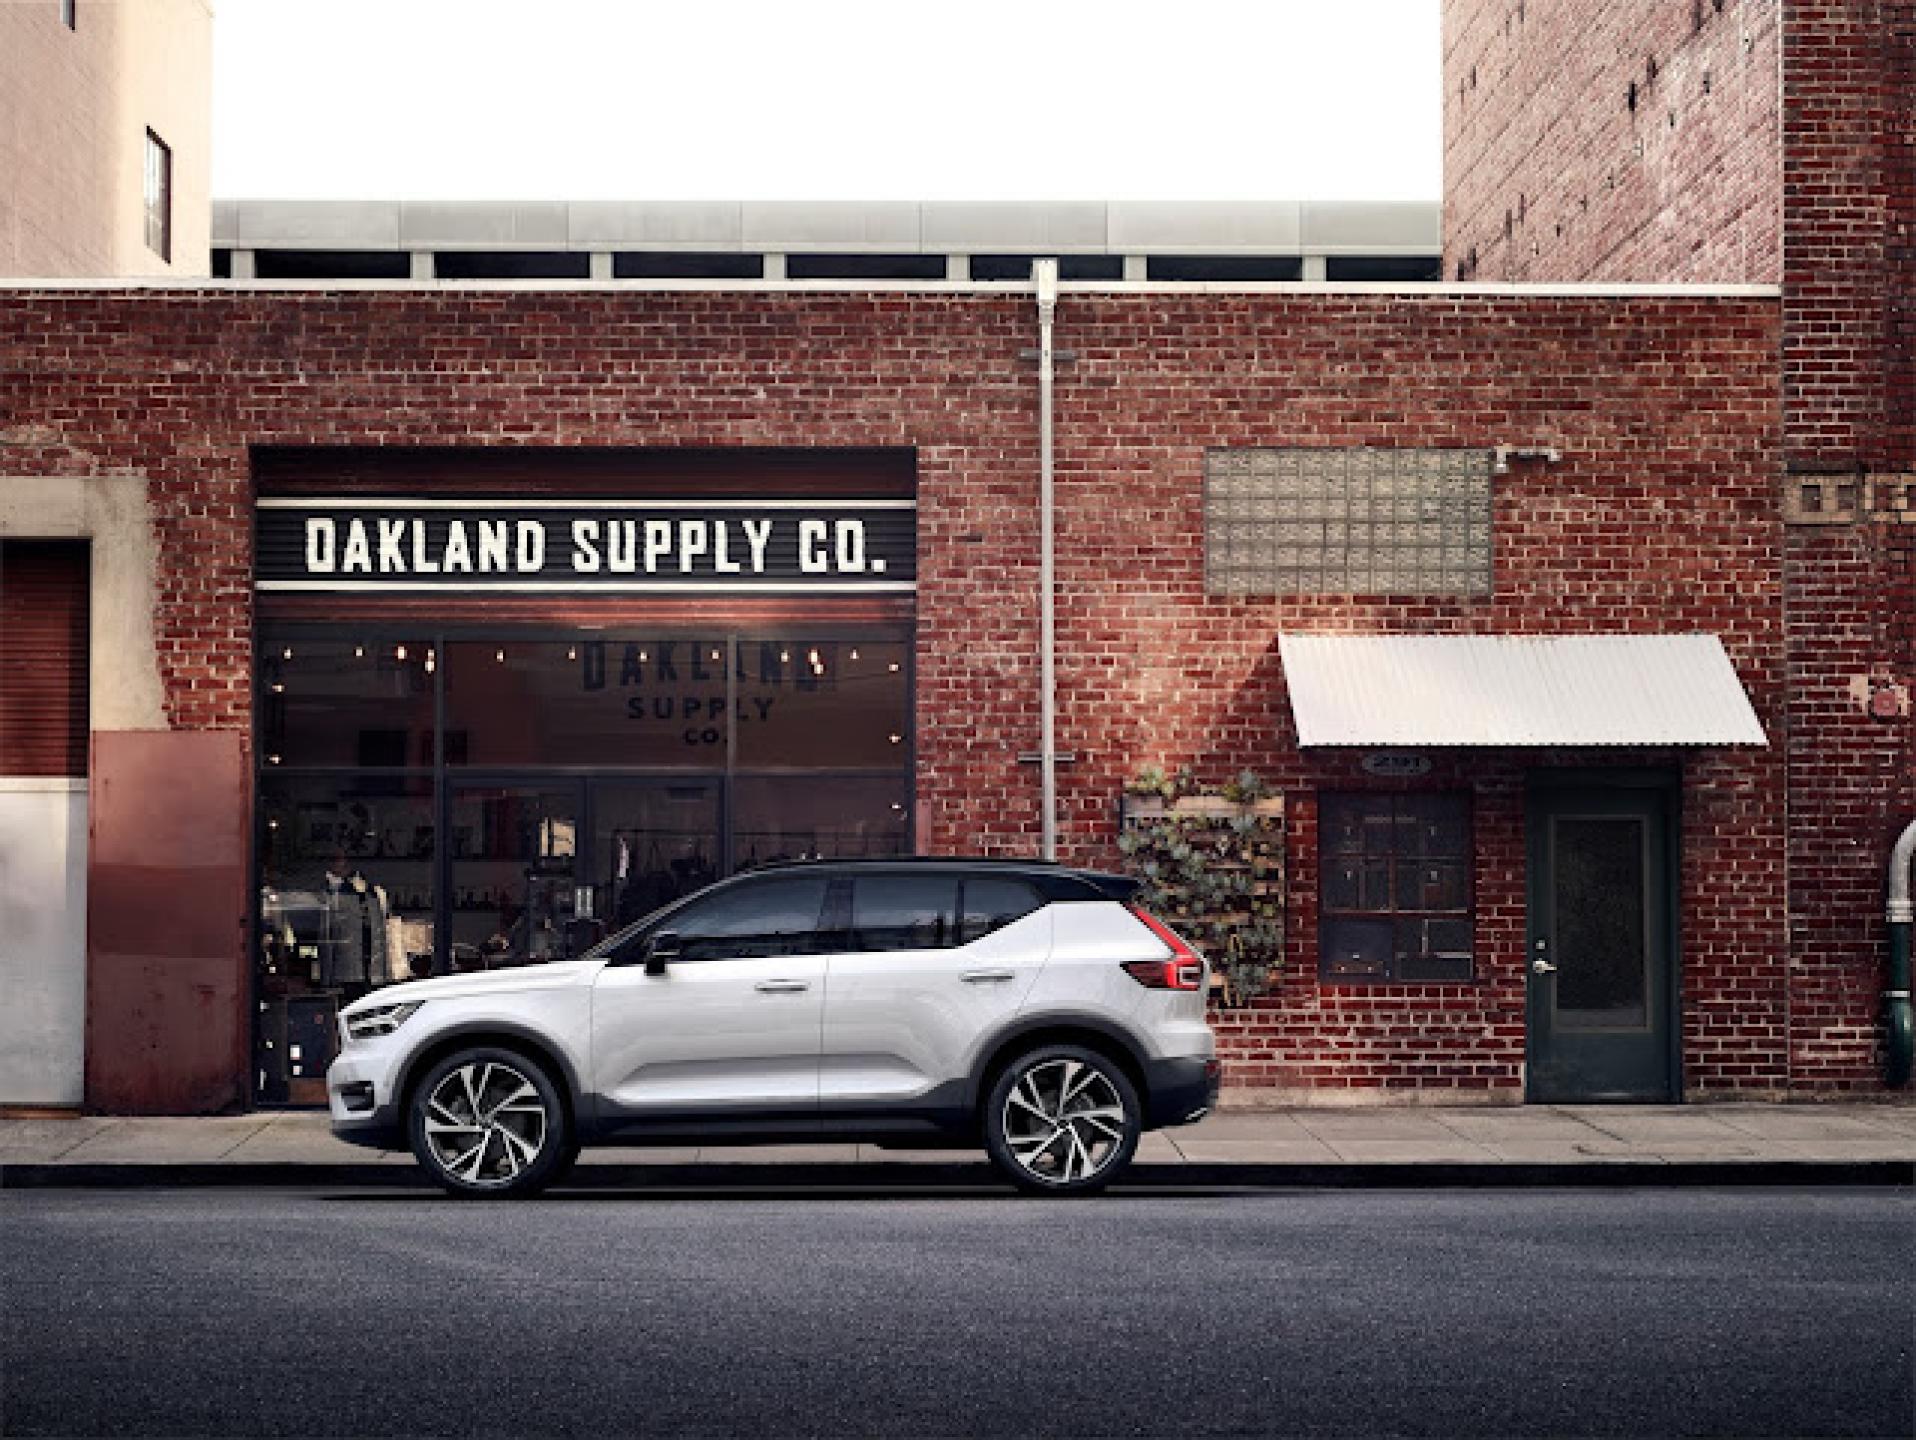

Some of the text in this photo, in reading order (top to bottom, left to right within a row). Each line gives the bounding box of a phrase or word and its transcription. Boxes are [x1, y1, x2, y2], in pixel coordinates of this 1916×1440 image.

[305, 517, 886, 573] OAKLAND SUPPLY CO.
[627, 697, 773, 720] SUPPLY
